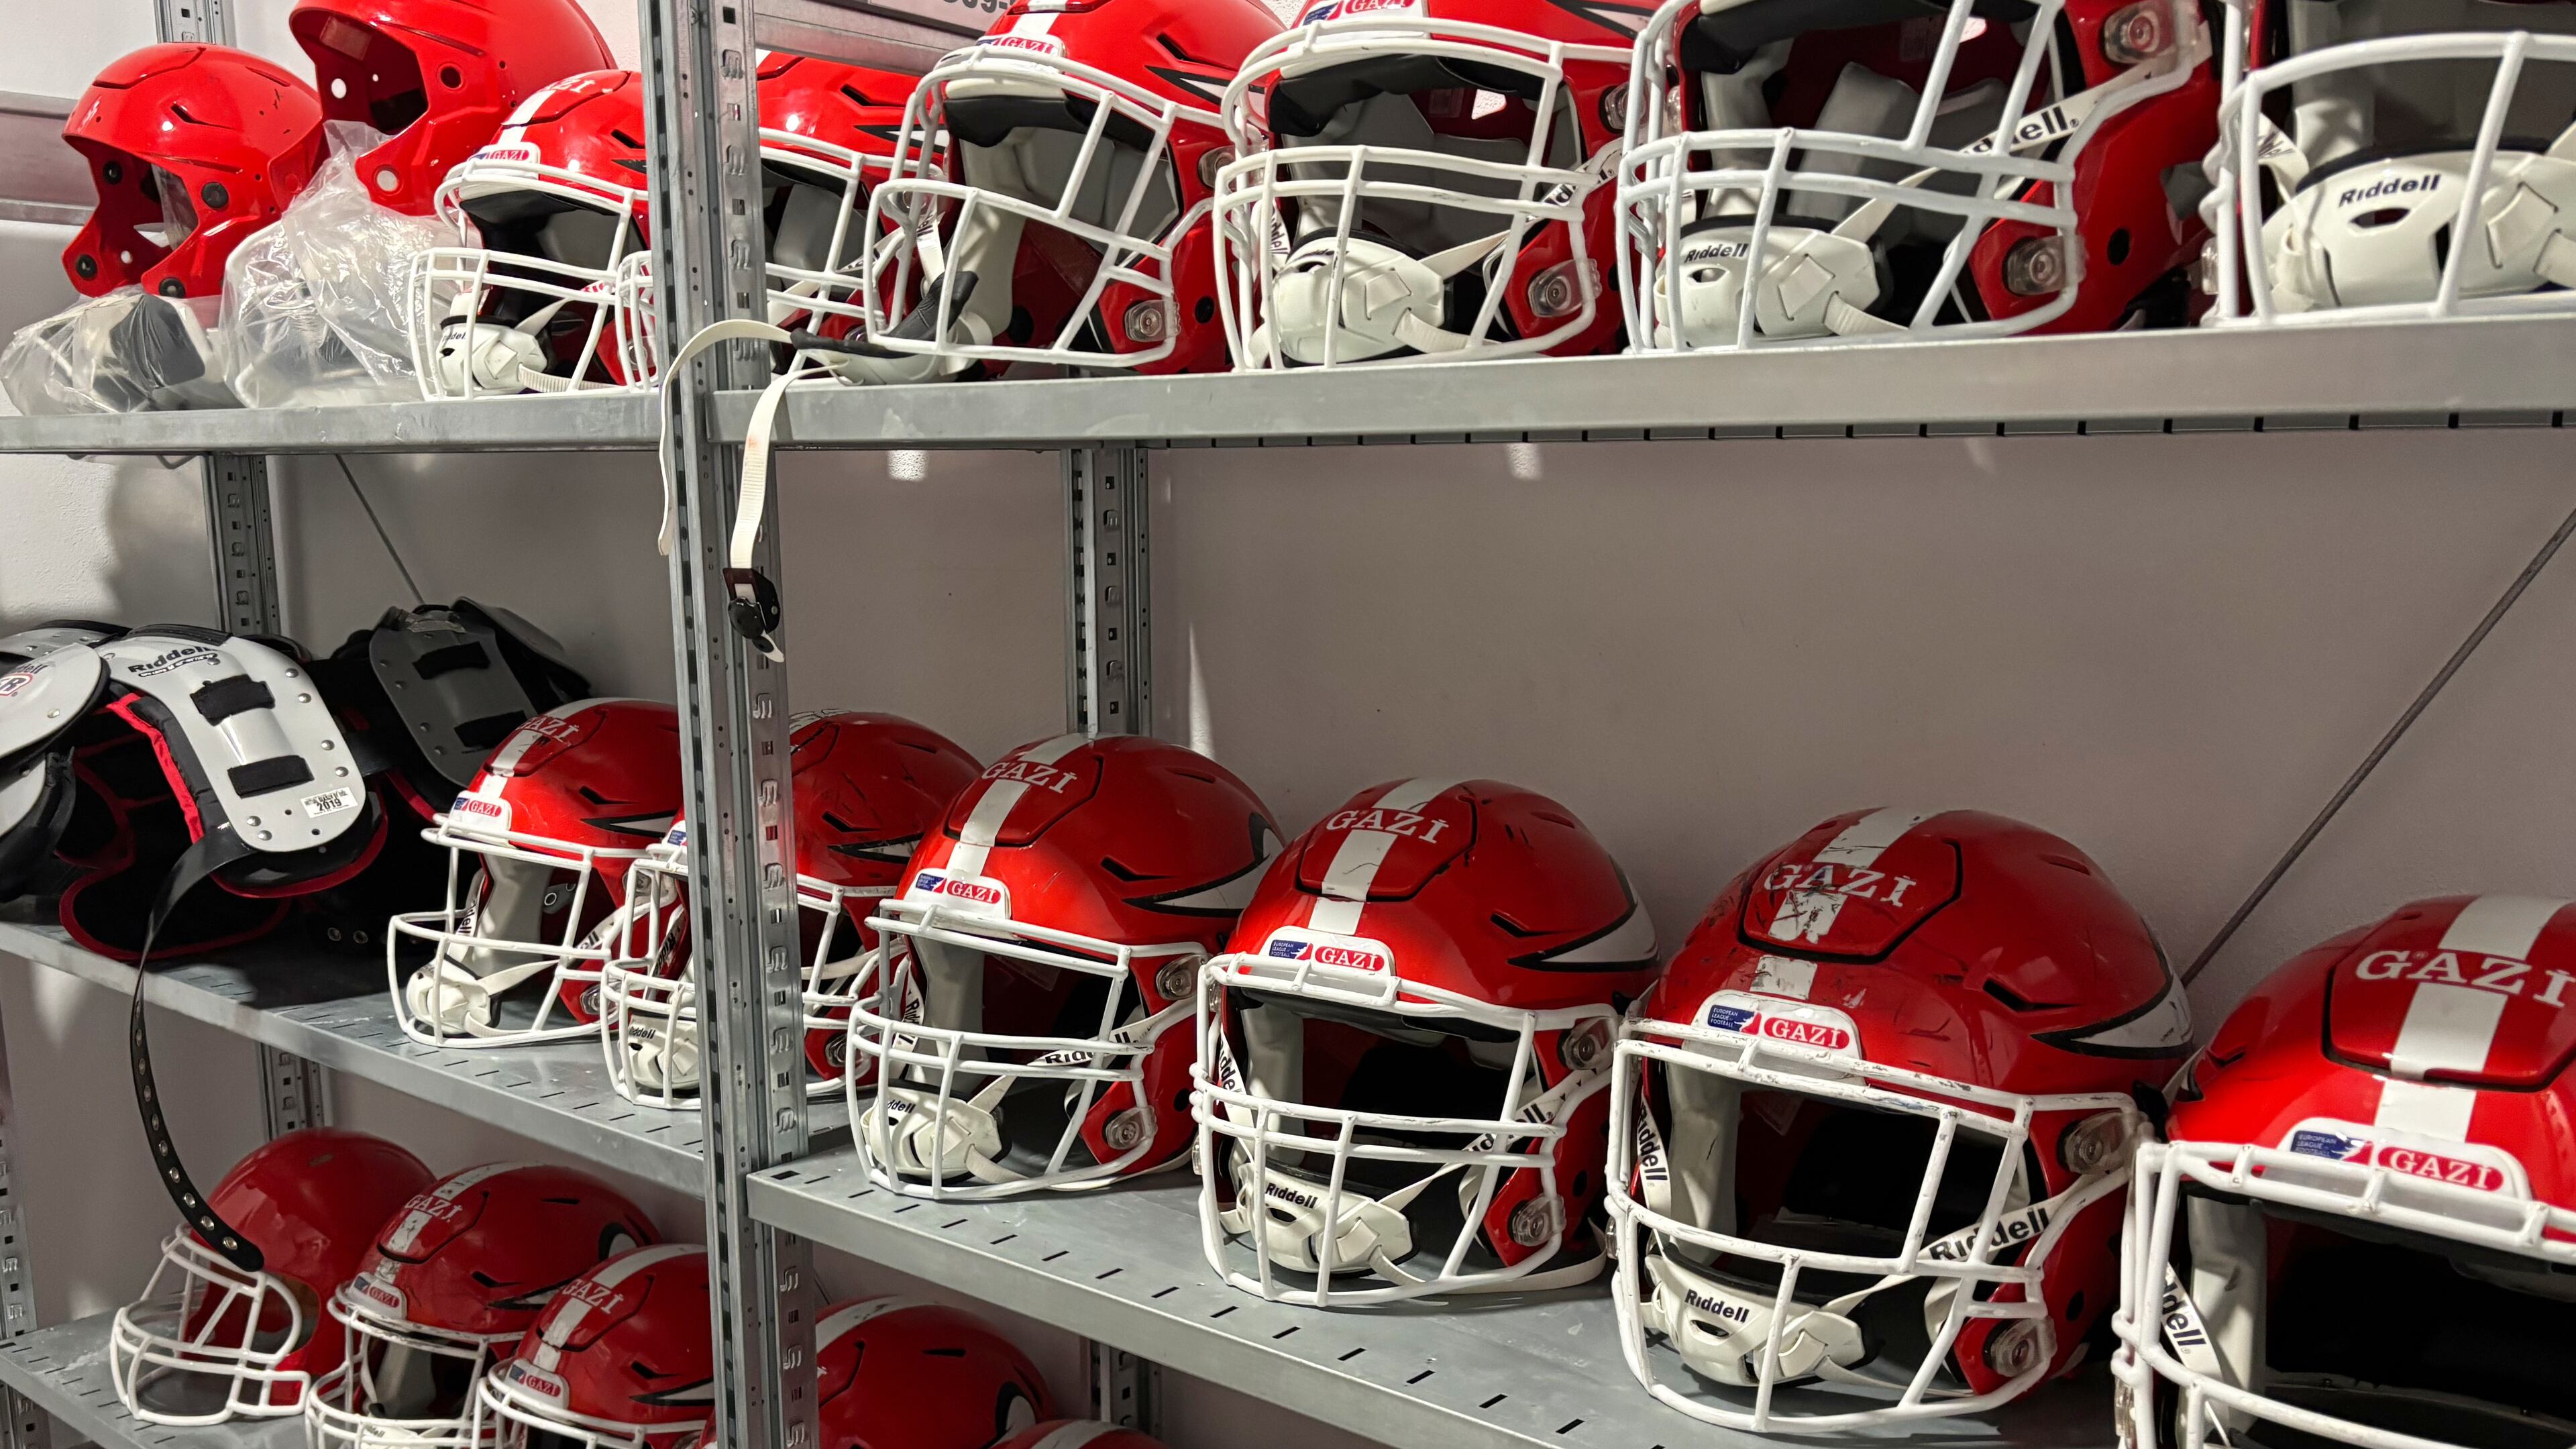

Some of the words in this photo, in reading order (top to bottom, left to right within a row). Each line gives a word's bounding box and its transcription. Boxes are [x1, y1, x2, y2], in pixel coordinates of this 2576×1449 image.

[2339, 174, 2440, 207] Riddell
[1684, 243, 1749, 264] Riddell
[1265, 1182, 1318, 1210] Riddell
[1684, 1288, 1750, 1323] Riddell
